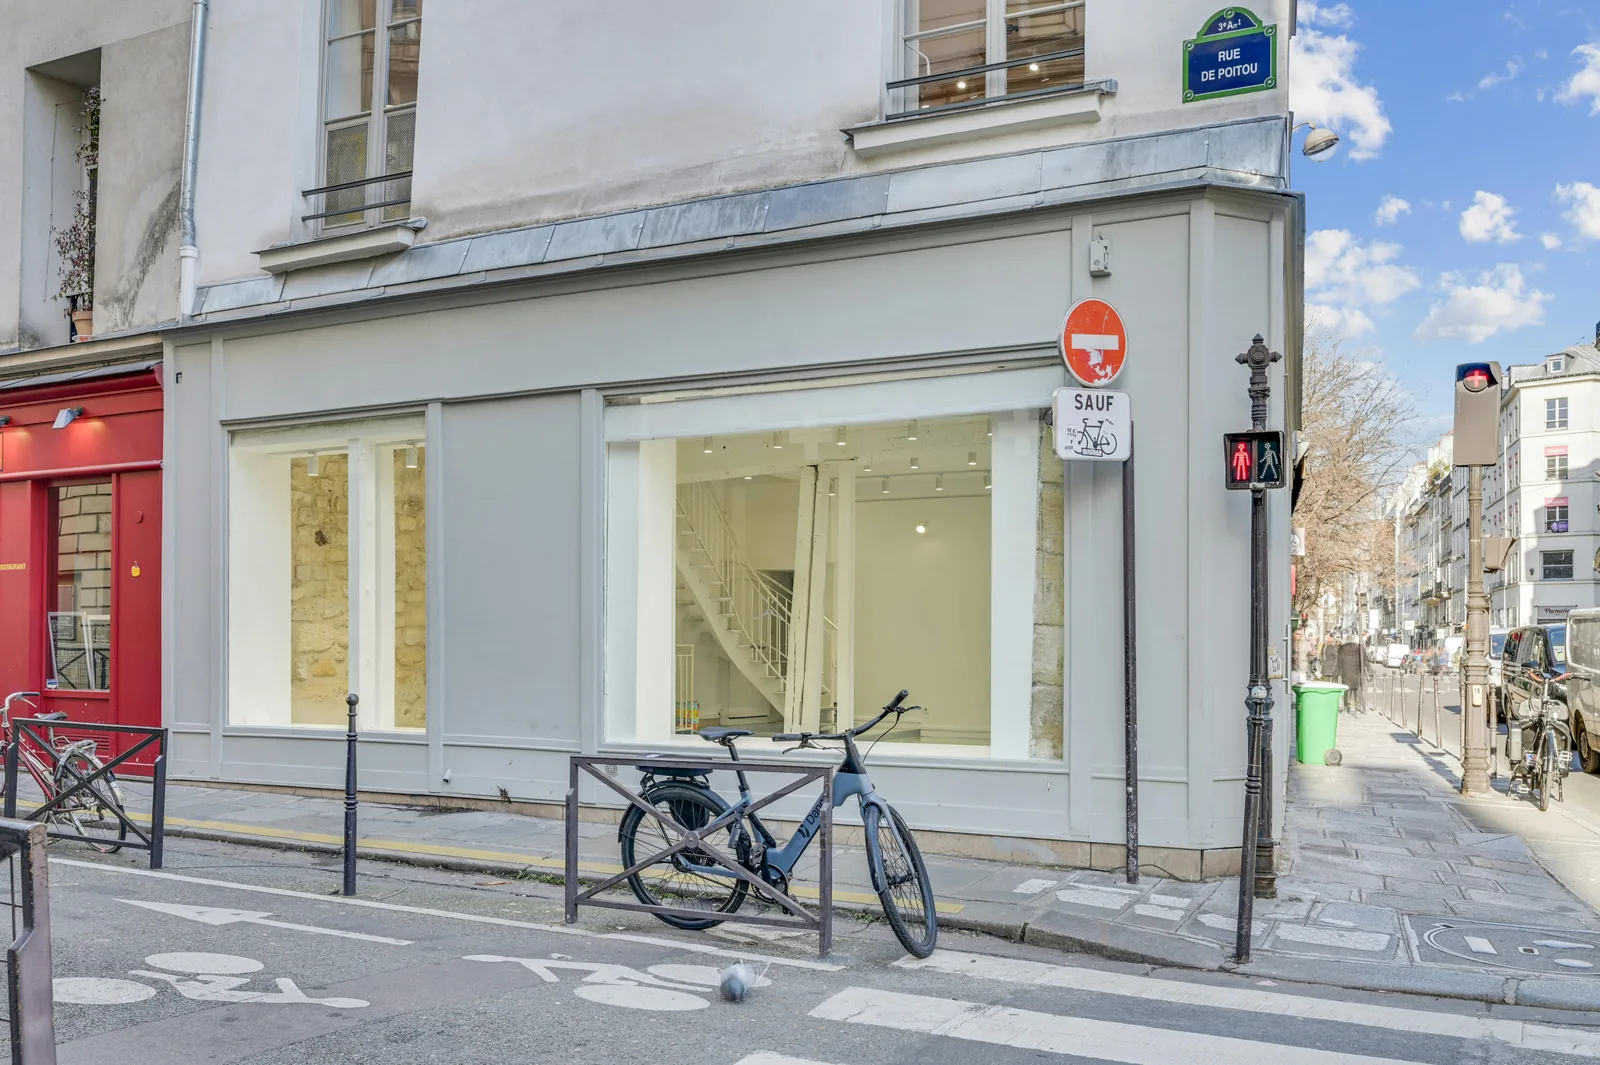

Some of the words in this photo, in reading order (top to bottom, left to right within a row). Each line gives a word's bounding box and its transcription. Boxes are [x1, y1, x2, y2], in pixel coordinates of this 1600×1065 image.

[1218, 48, 1241, 62] RUE
[1201, 69, 1216, 82] DE
[1218, 62, 1258, 79] POITOU
[1074, 393, 1114, 412] SAUF
